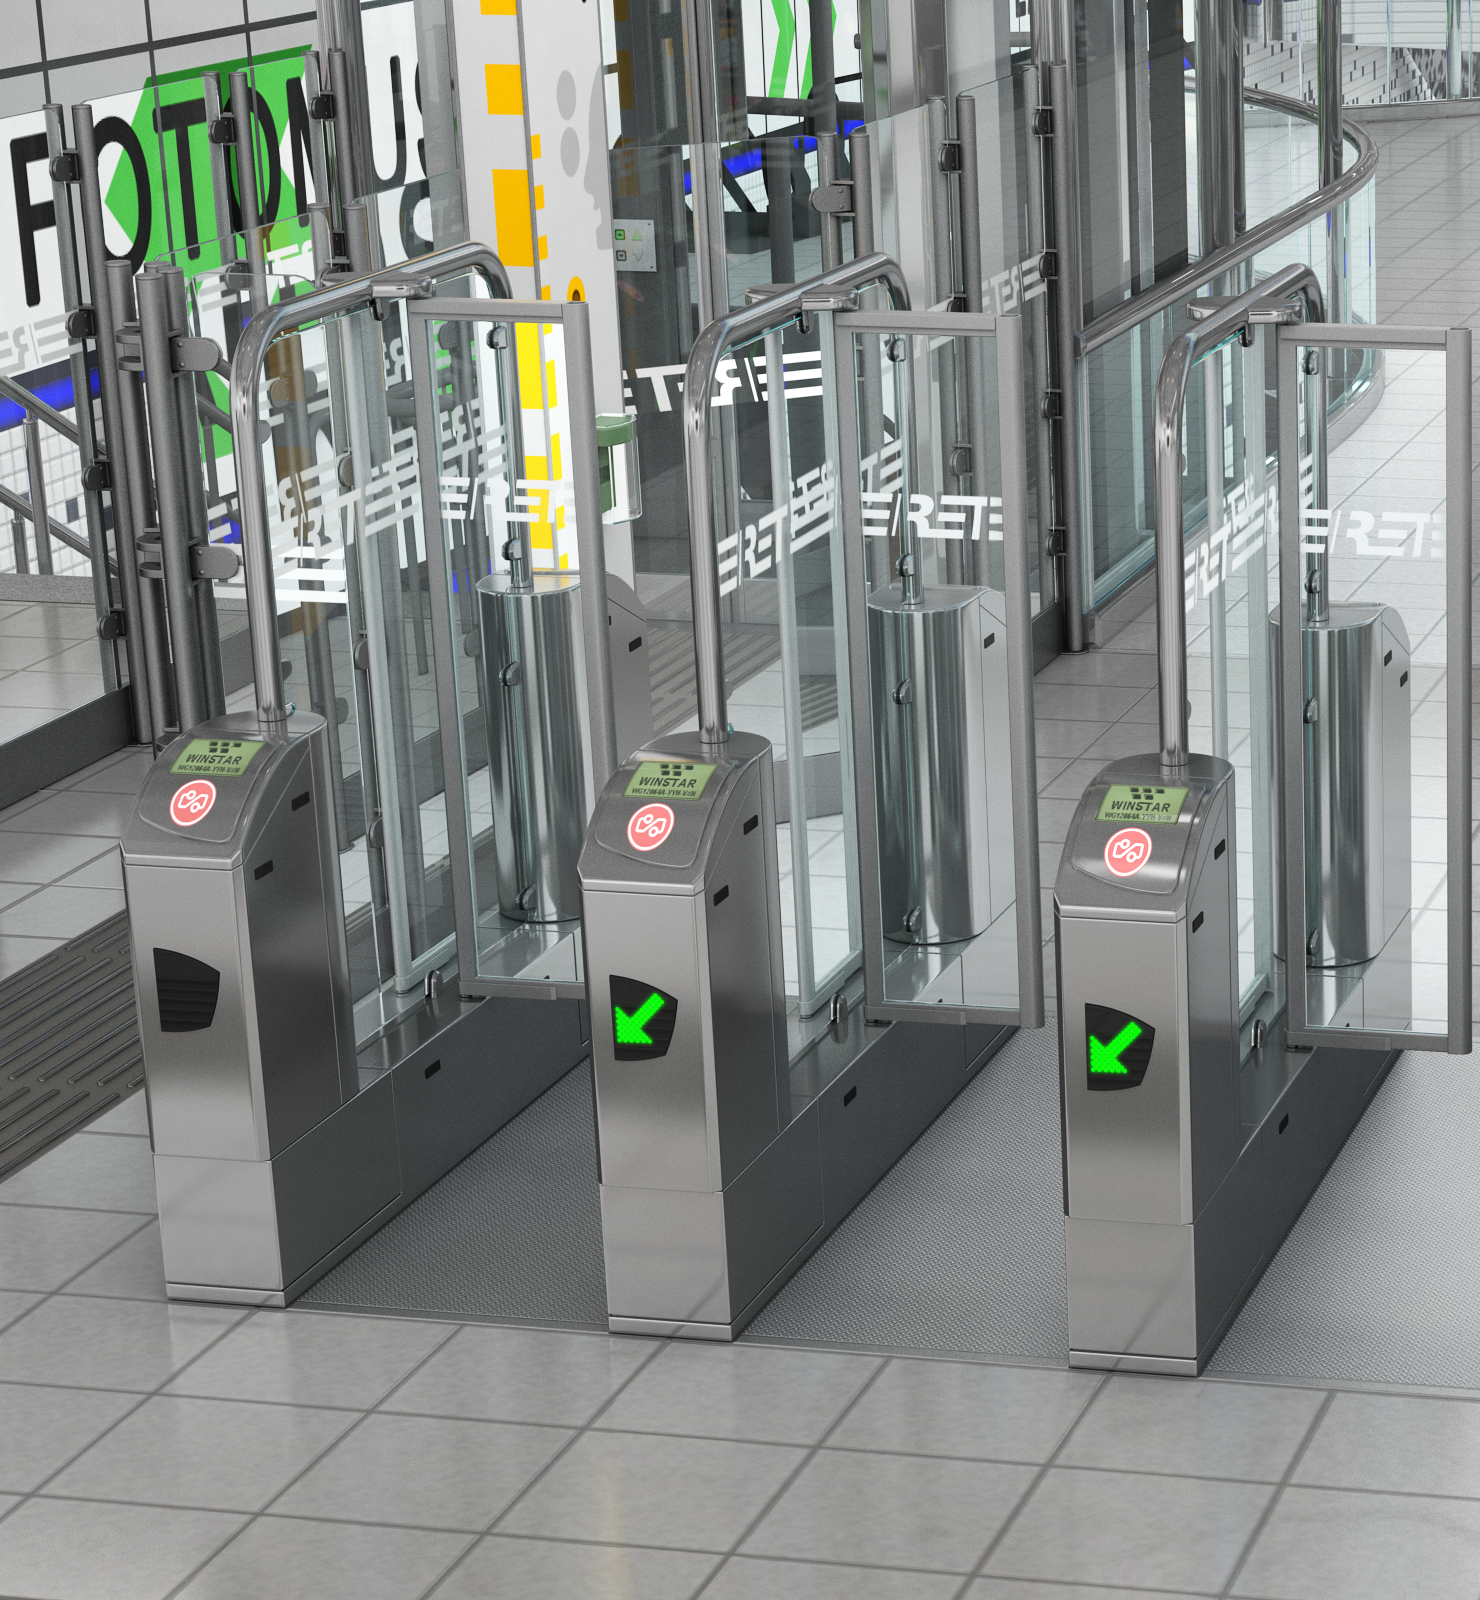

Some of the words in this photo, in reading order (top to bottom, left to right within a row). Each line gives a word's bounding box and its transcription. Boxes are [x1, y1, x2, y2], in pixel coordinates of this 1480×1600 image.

[185, 753, 243, 765] WINSTAR
[638, 776, 697, 789] WINSTAR
[1111, 800, 1171, 813] WINSTAR
